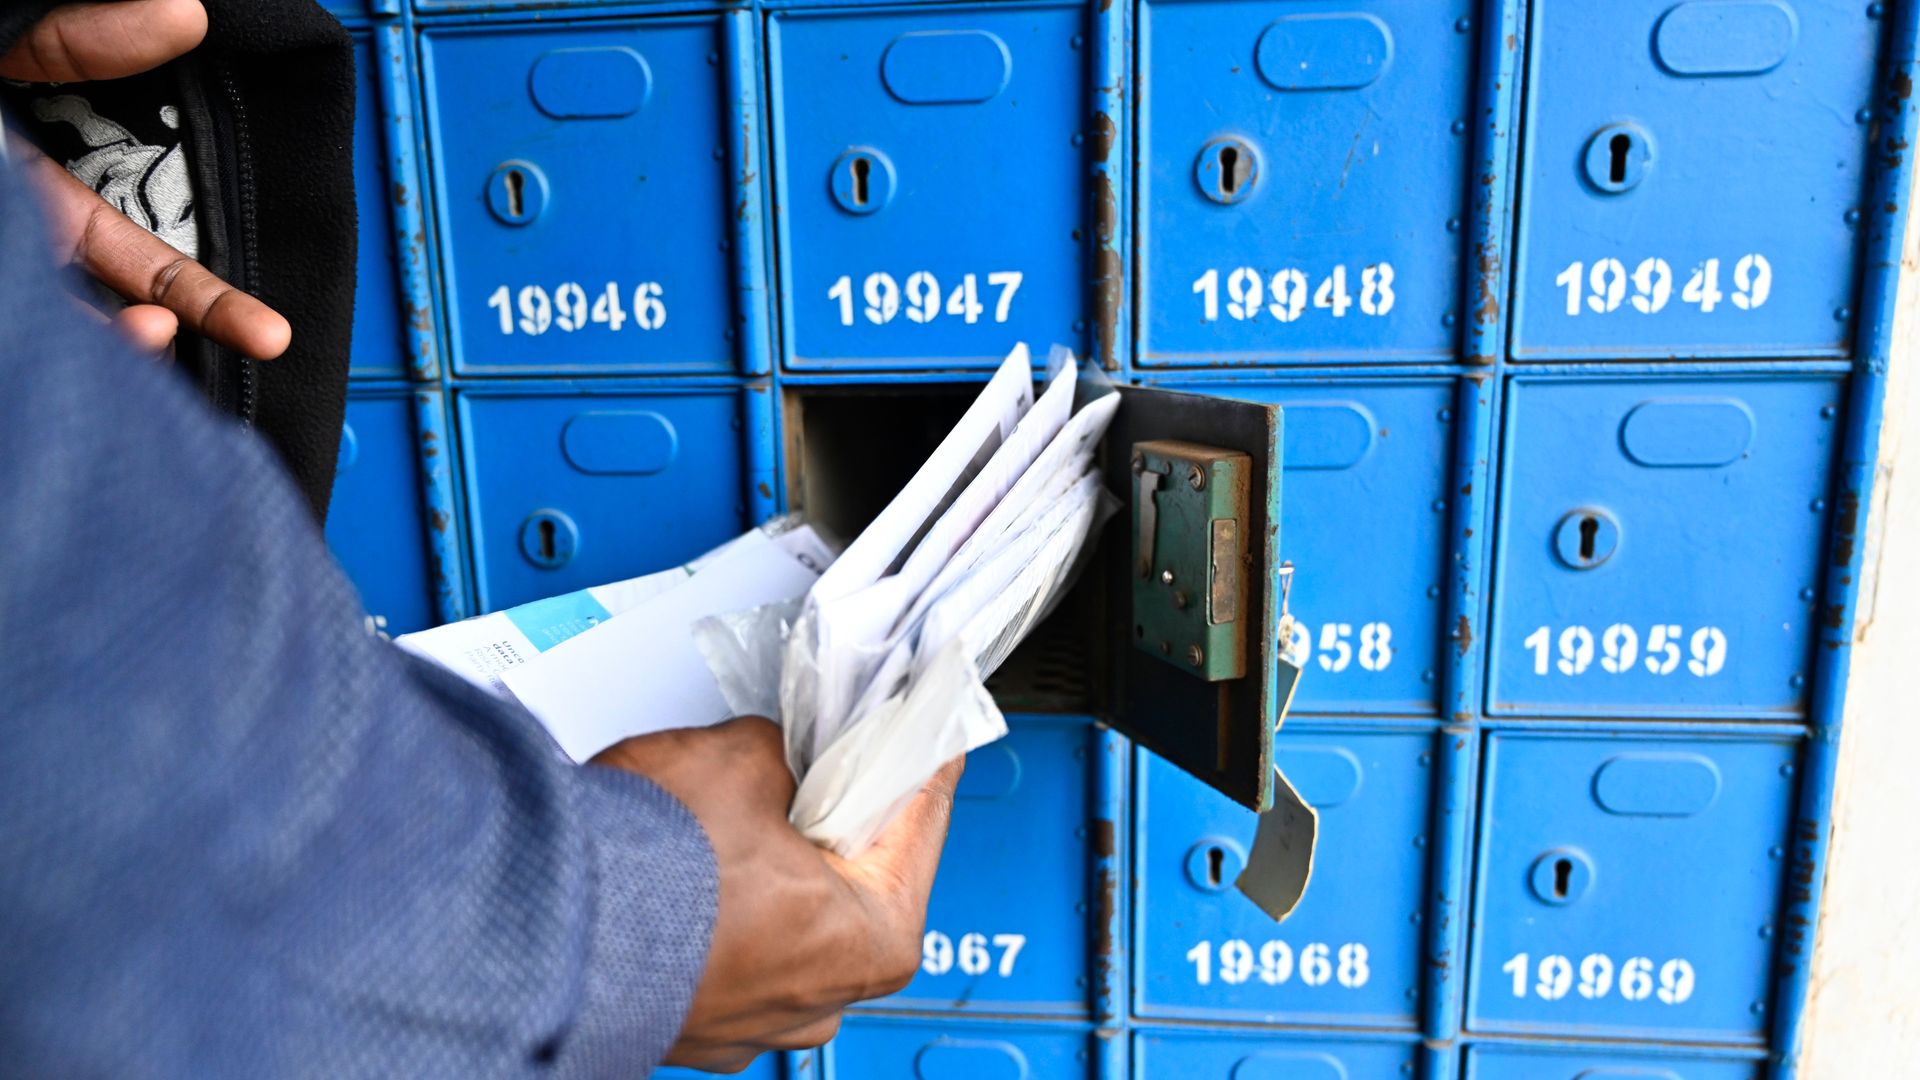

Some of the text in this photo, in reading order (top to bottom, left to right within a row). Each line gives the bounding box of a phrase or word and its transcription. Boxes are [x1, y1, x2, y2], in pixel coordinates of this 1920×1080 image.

[488, 282, 667, 335] 19946
[828, 271, 1023, 326] 19947
[1192, 261, 1396, 323] 19948
[1555, 253, 1773, 316] 19949
[1293, 620, 1393, 673] 958
[1523, 622, 1728, 678] 19959
[921, 929, 1027, 978] 967
[1186, 939, 1371, 988] 19968
[1502, 953, 1696, 1006] 19969
